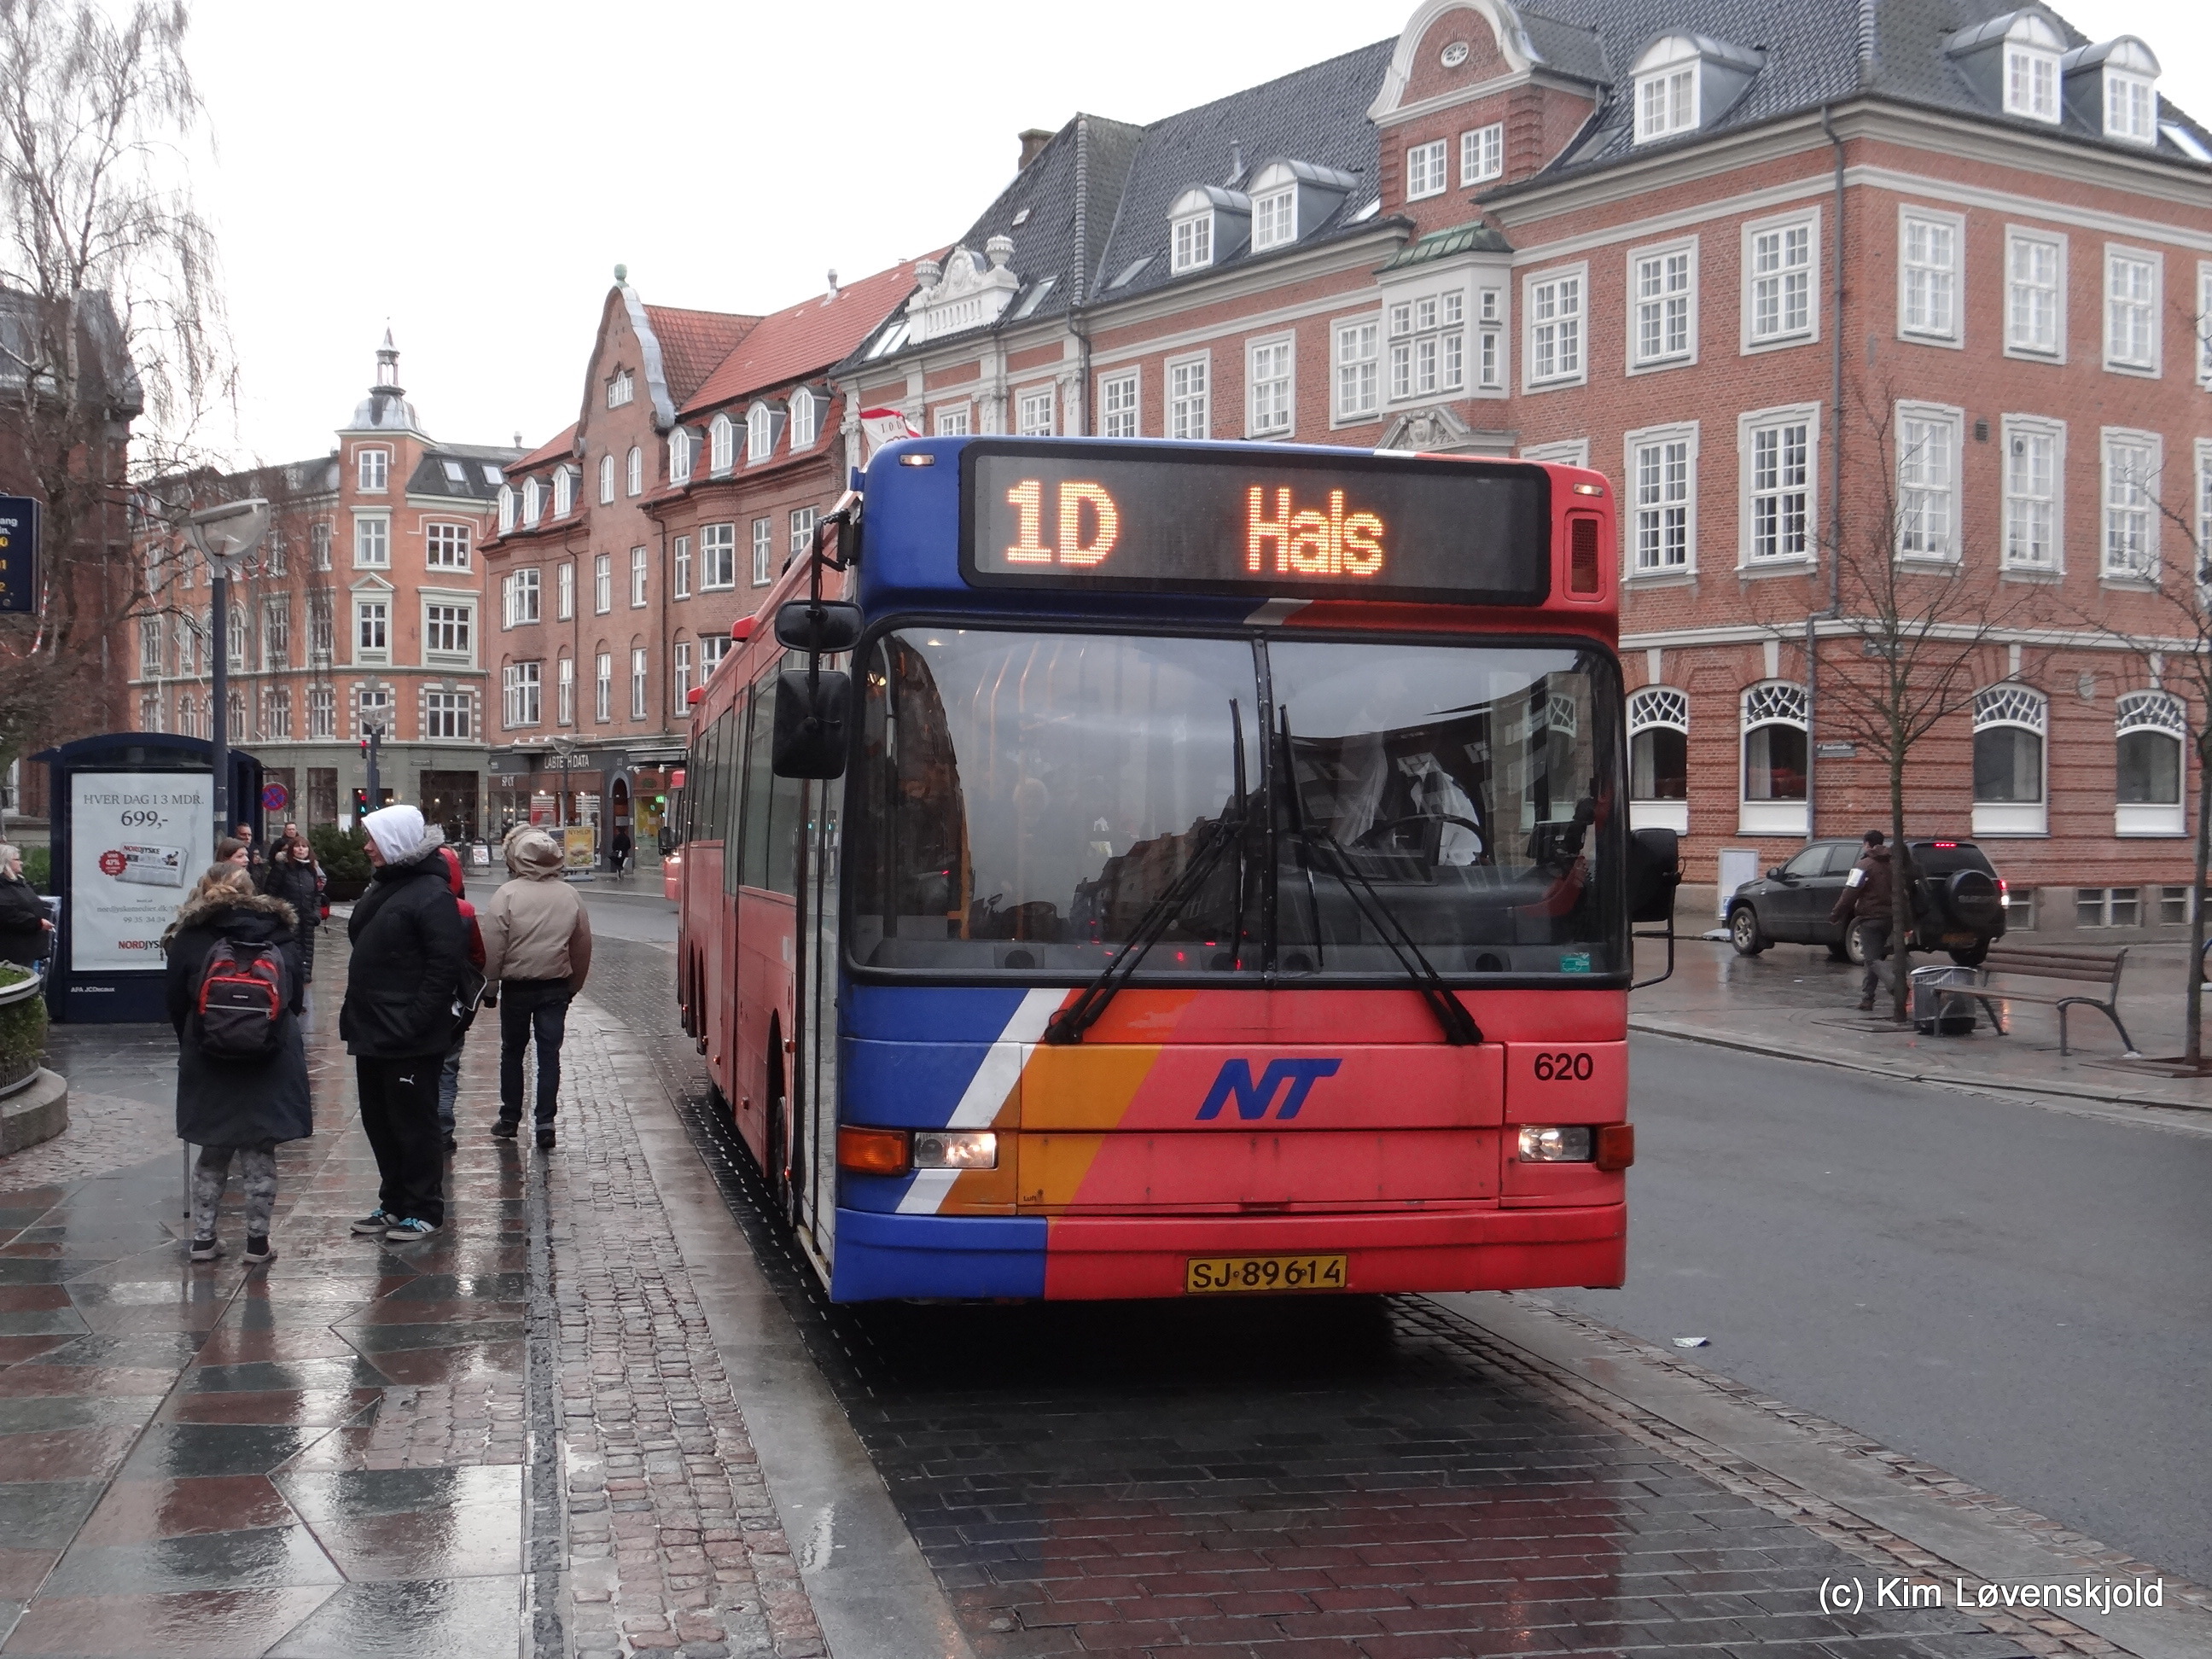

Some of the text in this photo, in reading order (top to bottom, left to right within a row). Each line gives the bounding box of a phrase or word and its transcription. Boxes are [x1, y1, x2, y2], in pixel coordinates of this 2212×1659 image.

[1005, 479, 1384, 577] 1D Hals
[544, 754, 572, 769] LABTEH
[84, 795, 119, 805] HVER
[124, 795, 149, 805] DAG
[160, 795, 169, 805] 3
[172, 795, 204, 805] MDR.
[121, 810, 168, 830] 699,-
[119, 940, 160, 950] NORDJYS
[1534, 1052, 1594, 1081] 620
[1195, 1058, 1343, 1121] NT
